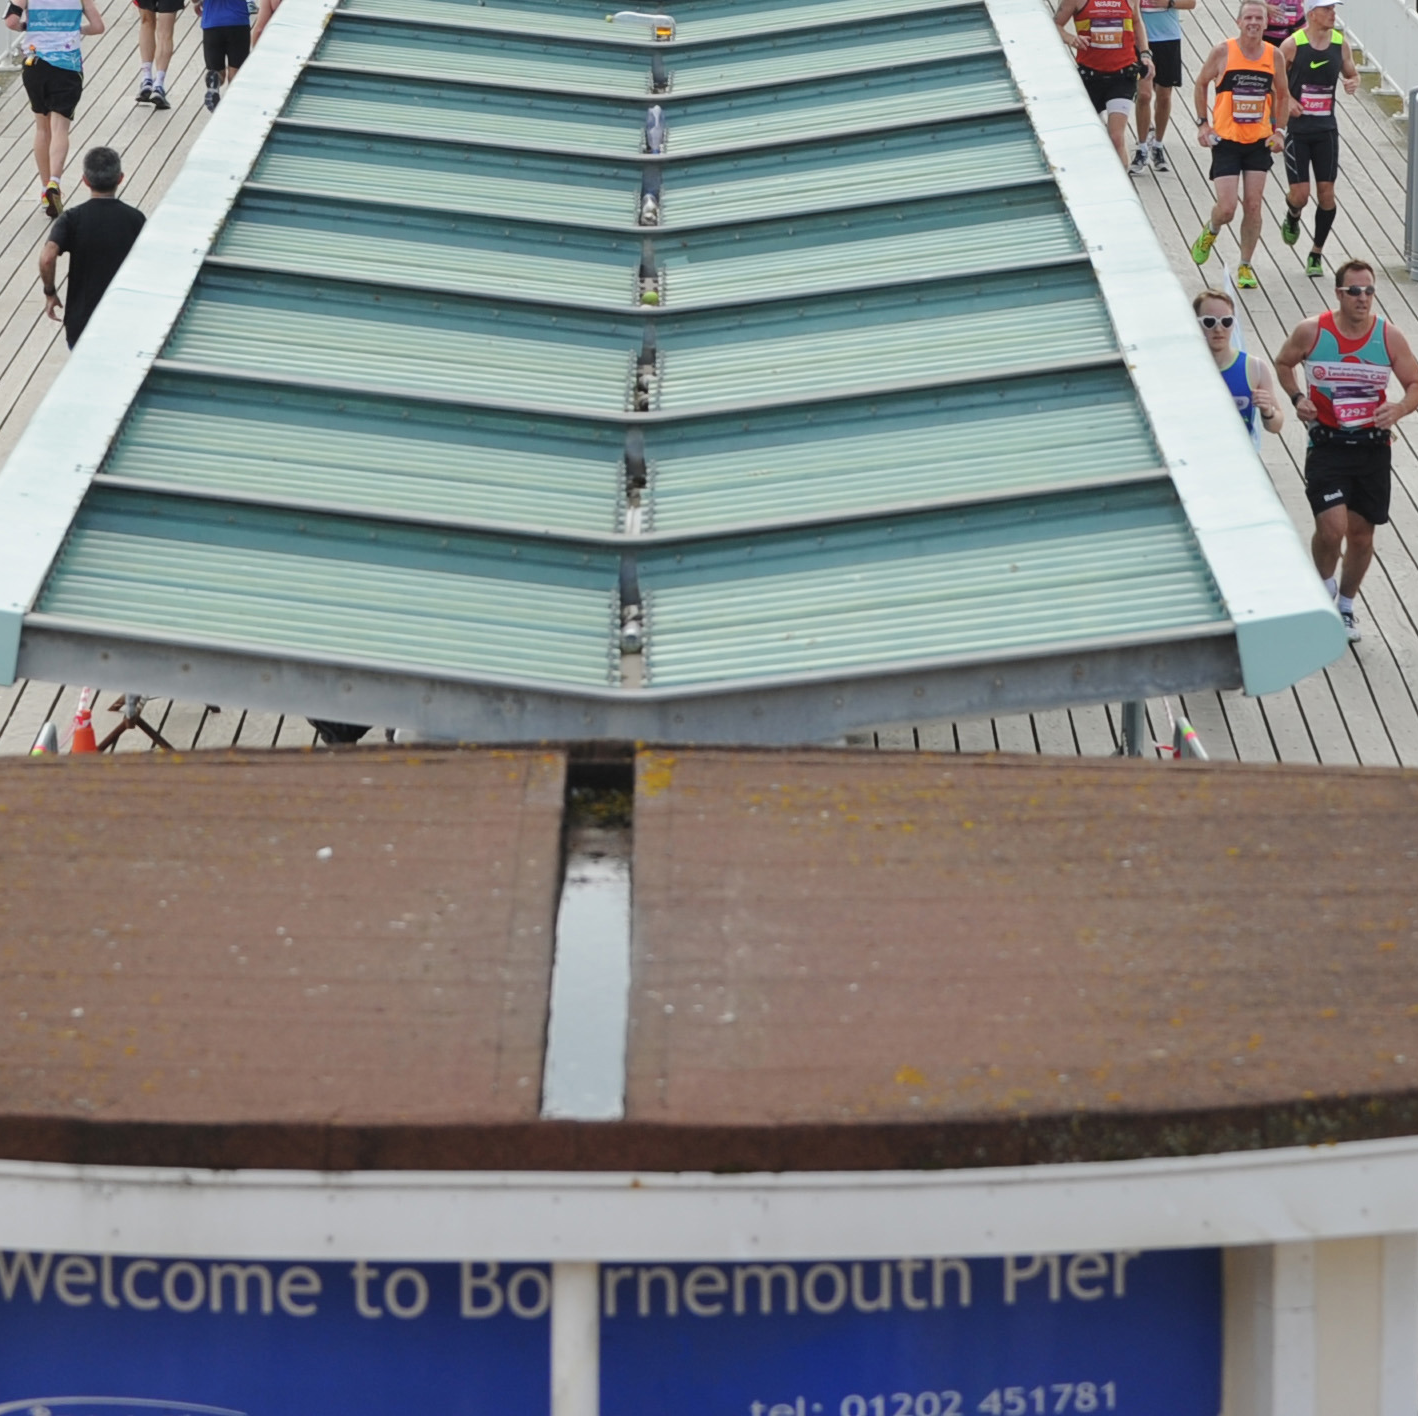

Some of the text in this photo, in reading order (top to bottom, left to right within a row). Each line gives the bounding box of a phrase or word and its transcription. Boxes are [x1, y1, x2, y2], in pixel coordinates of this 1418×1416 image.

[1340, 407, 1367, 418] 2292
[352, 1260, 430, 1319] to
[460, 1257, 971, 1320] Bornemouth
[1003, 1249, 1139, 1304] Pier
[839, 1389, 964, 1416] 01202
[977, 1381, 1117, 1416] 451781
